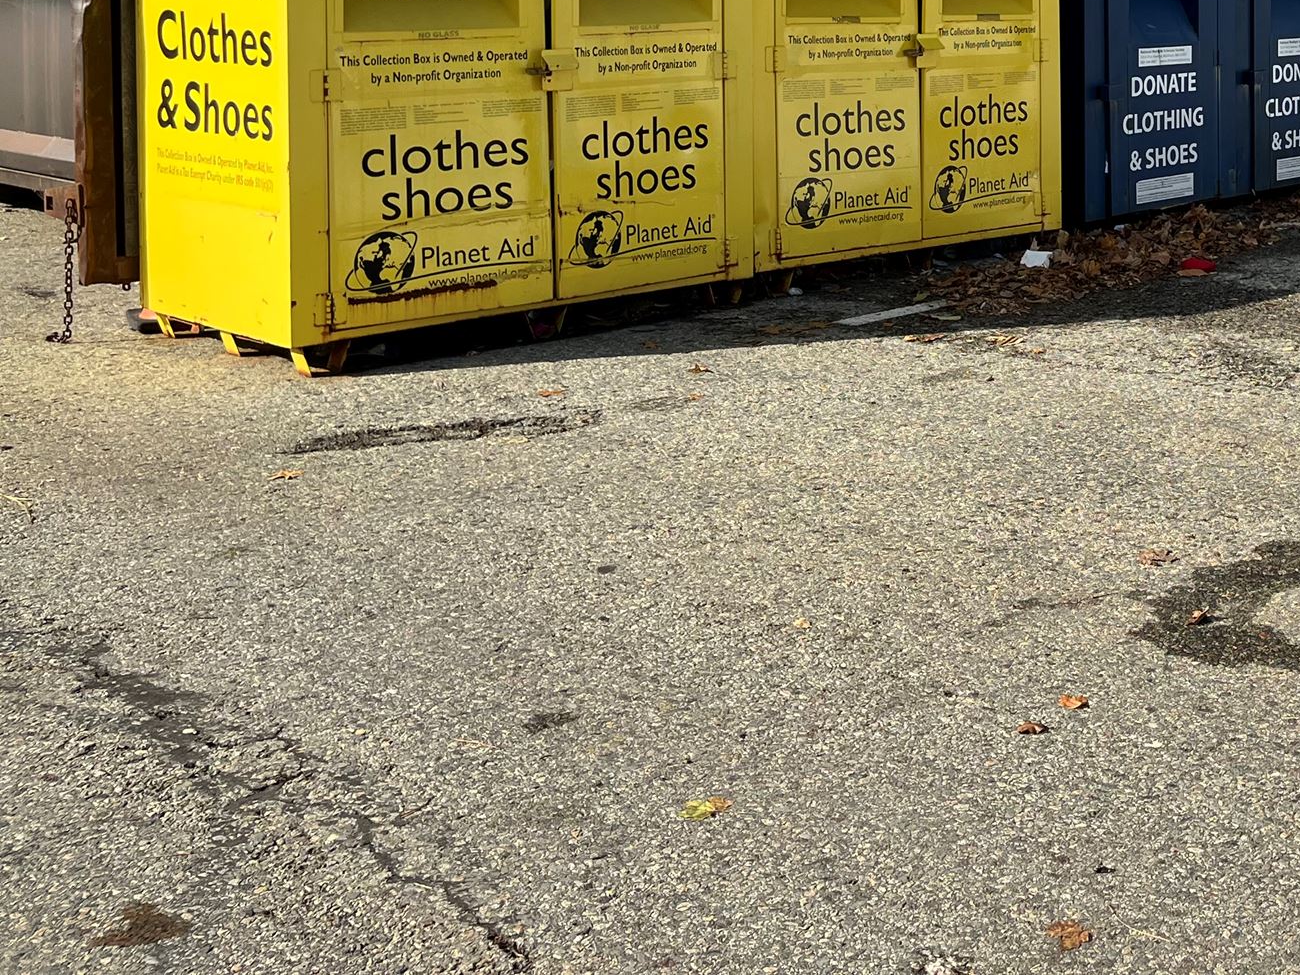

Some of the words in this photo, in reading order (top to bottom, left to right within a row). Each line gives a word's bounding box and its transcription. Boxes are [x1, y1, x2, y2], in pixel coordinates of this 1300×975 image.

[157, 9, 272, 68] Clothes
[432, 30, 459, 38] GLASS
[789, 35, 801, 44] This
[803, 35, 834, 44] Collection
[836, 35, 846, 43] Box
[849, 34, 853, 43] is
[855, 33, 875, 42] Owned
[877, 33, 881, 41] &
[883, 32, 911, 43] Operated
[939, 28, 948, 37] This
[950, 27, 975, 36] Collection
[976, 27, 985, 35] Box
[991, 26, 1008, 34] Owned
[1015, 25, 1035, 34] Operated
[575, 47, 590, 57] This
[593, 45, 628, 56] Collection
[631, 45, 643, 55] Box
[645, 44, 650, 54] is
[653, 44, 676, 54] Owned
[678, 43, 683, 52] &
[686, 42, 717, 54] Operated
[809, 50, 816, 59] by
[822, 49, 853, 59] Non-profit
[855, 48, 893, 57] Organization
[954, 41, 960, 50] by
[991, 39, 1022, 49] Organization
[340, 56, 360, 67] This
[363, 54, 410, 66] Collection
[413, 54, 431, 63] Box
[434, 53, 440, 63] is
[443, 51, 474, 62] Owned
[477, 51, 483, 61] &
[486, 50, 528, 63] Operated
[598, 64, 606, 73] by
[615, 61, 650, 72] Non-profit
[653, 59, 696, 70] Organization
[371, 73, 382, 86] by
[384, 75, 390, 83] a
[393, 71, 440, 84] Non-profit
[443, 68, 501, 82] Organization
[1131, 72, 1196, 97] DONATE
[157, 78, 177, 129] &
[184, 81, 273, 142] Shoes
[796, 100, 905, 137] clothes
[940, 94, 1027, 128] clothes
[1122, 107, 1203, 135] CLOTHING
[582, 116, 708, 160] clothes
[949, 129, 1018, 161] shoes
[1272, 132, 1282, 150] &
[362, 129, 529, 177] clothes
[809, 138, 895, 172] shoes
[1130, 150, 1142, 172] &
[1146, 143, 1198, 169] SHOES
[597, 160, 696, 199] shoes
[970, 177, 1005, 194] Planet
[1010, 171, 1028, 189] Aid
[382, 178, 513, 220] shoes
[835, 192, 879, 209] Planet
[884, 186, 908, 205] Aid
[973, 196, 1026, 209] www.planetaid.org
[627, 223, 678, 244] Planet
[684, 214, 712, 237] Aid
[839, 212, 903, 225] www.planetaid.org
[422, 245, 490, 268] Planet
[498, 236, 534, 260] Aid
[632, 244, 707, 262] www.planetaid.org
